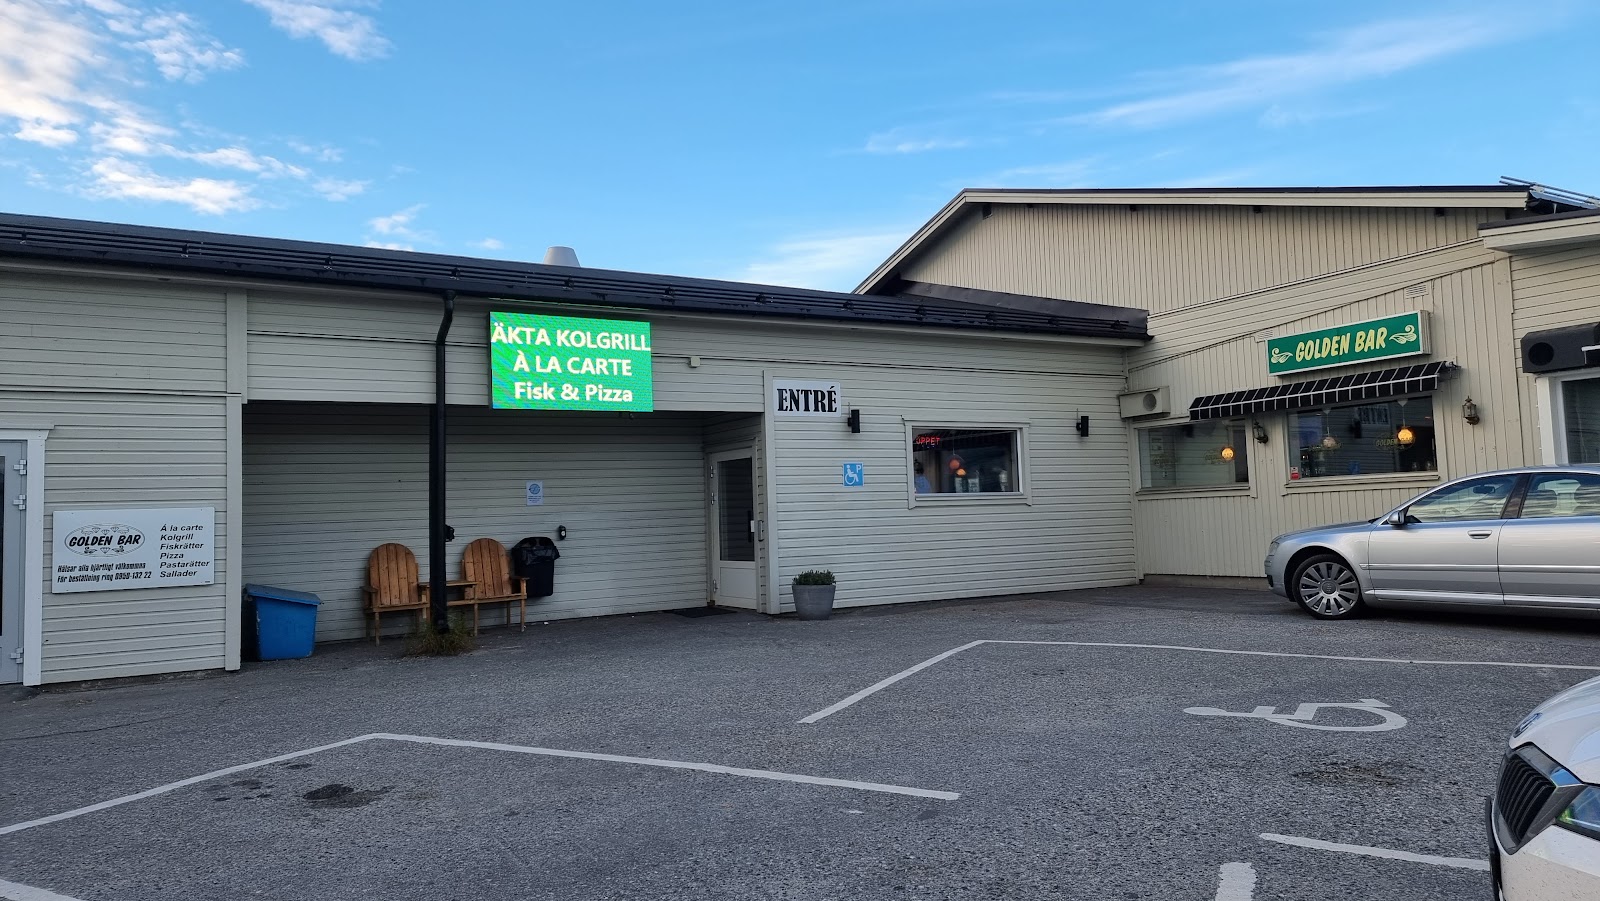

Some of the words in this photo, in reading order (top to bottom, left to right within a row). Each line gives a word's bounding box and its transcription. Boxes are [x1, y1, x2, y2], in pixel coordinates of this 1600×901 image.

[491, 322, 551, 346] ÄKTA
[557, 329, 651, 351] KOLGRILL
[1295, 332, 1351, 362] GOLDEN
[1354, 327, 1388, 353] BAR
[513, 350, 530, 372] À
[536, 355, 562, 374] LA
[567, 357, 633, 376] CARTE
[514, 381, 555, 400] Fisk
[561, 383, 580, 401] &
[585, 384, 633, 402] Pizza
[777, 385, 837, 413] ENTRÉ
[855, 464, 862, 474] P
[170, 524, 178, 532] la
[180, 524, 204, 532] carte
[69, 535, 113, 547] GOLDEN
[117, 534, 141, 546] BAR
[160, 533, 194, 542] Kolgrill
[160, 552, 184, 560] Pizza
[78, 564, 90, 572] alla
[160, 560, 210, 569] Pastarätter
[57, 575, 68, 583] För
[68, 573, 101, 583] beställning
[101, 572, 114, 581] ring
[143, 571, 152, 579] 22
[160, 570, 198, 578] Sallader
